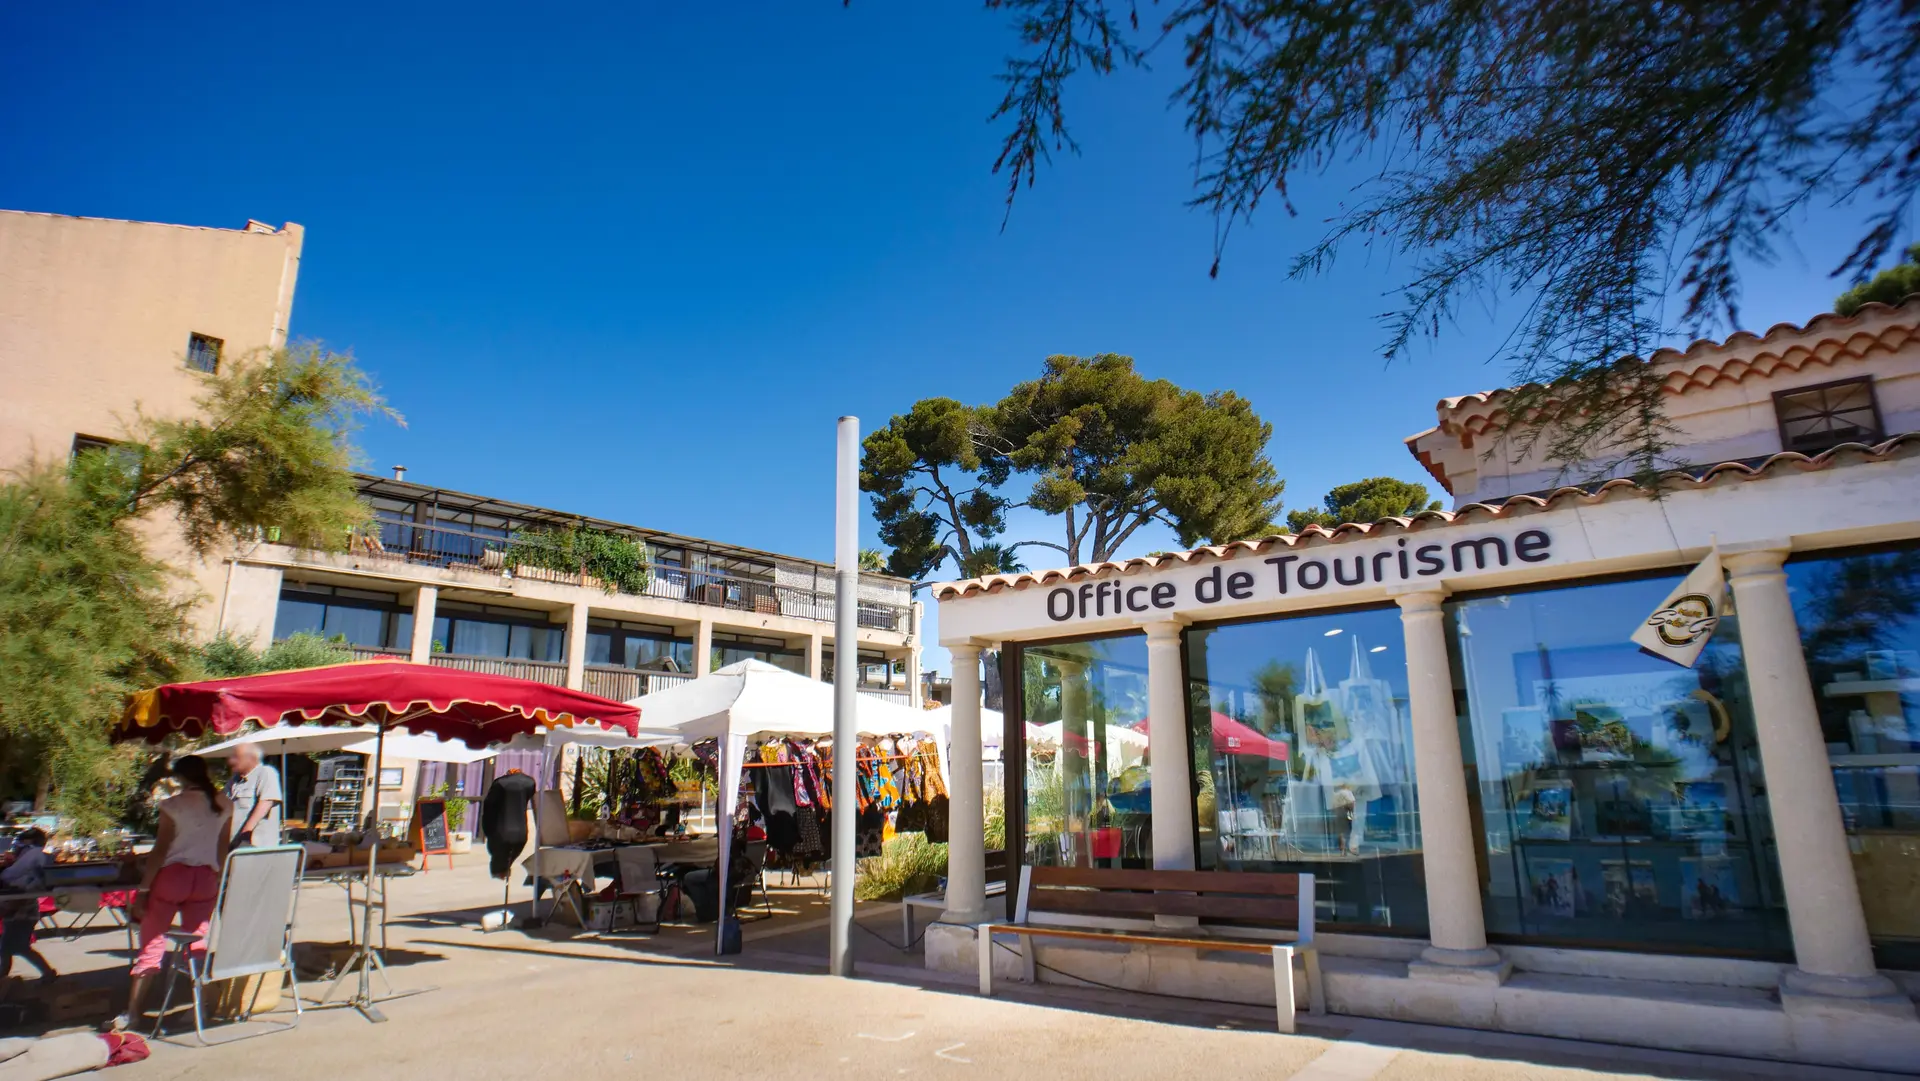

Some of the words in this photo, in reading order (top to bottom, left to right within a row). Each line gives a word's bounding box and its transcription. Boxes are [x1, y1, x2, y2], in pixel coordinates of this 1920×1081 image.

[1047, 579, 1177, 622] Office
[1194, 565, 1255, 604] de
[1264, 529, 1551, 595] Tourisme
